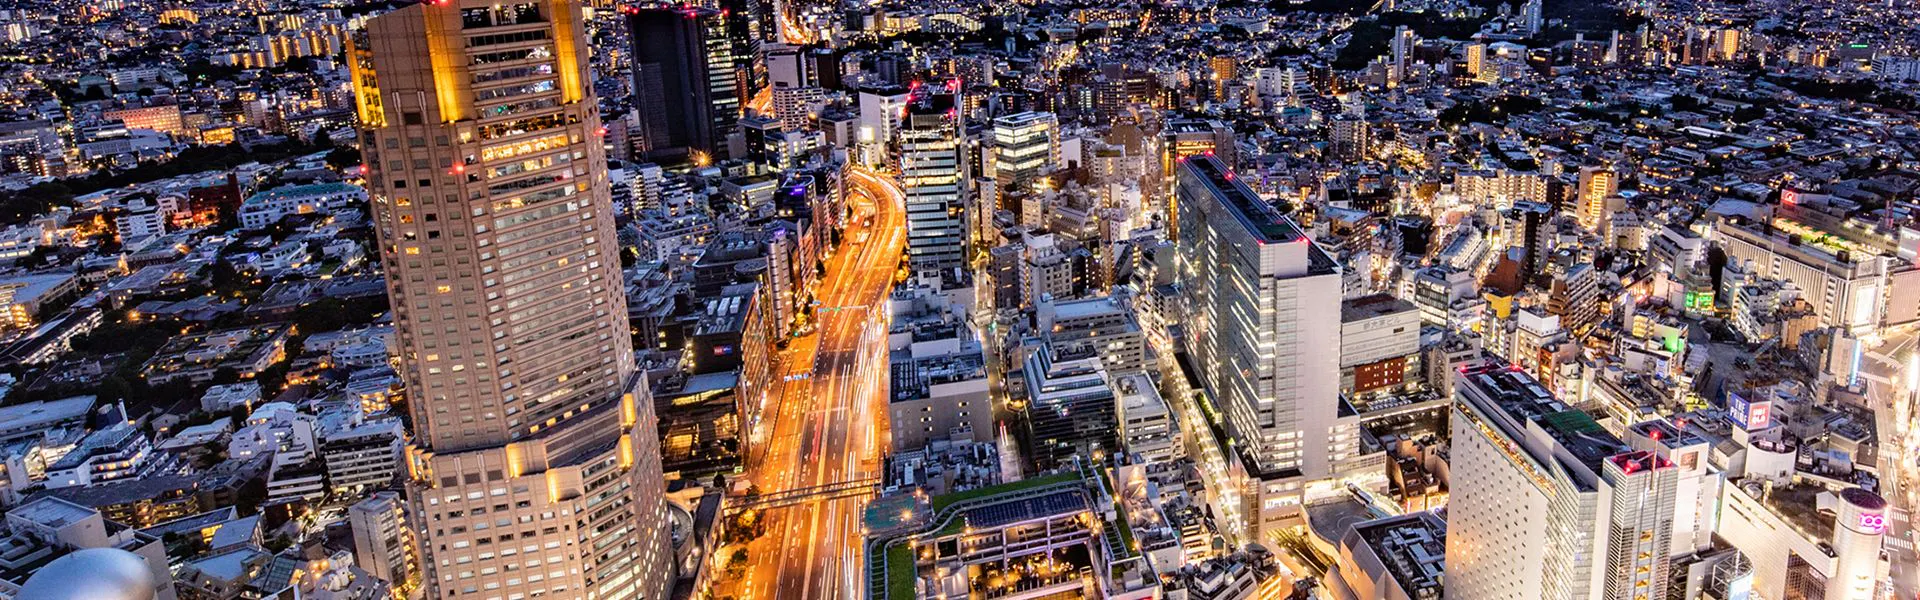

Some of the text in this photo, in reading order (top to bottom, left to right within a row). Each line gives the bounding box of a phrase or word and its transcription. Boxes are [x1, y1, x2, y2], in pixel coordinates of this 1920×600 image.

[1730, 406, 1747, 426] PRIME
[1735, 398, 1746, 414] THE
[1860, 513, 1885, 533] 109
